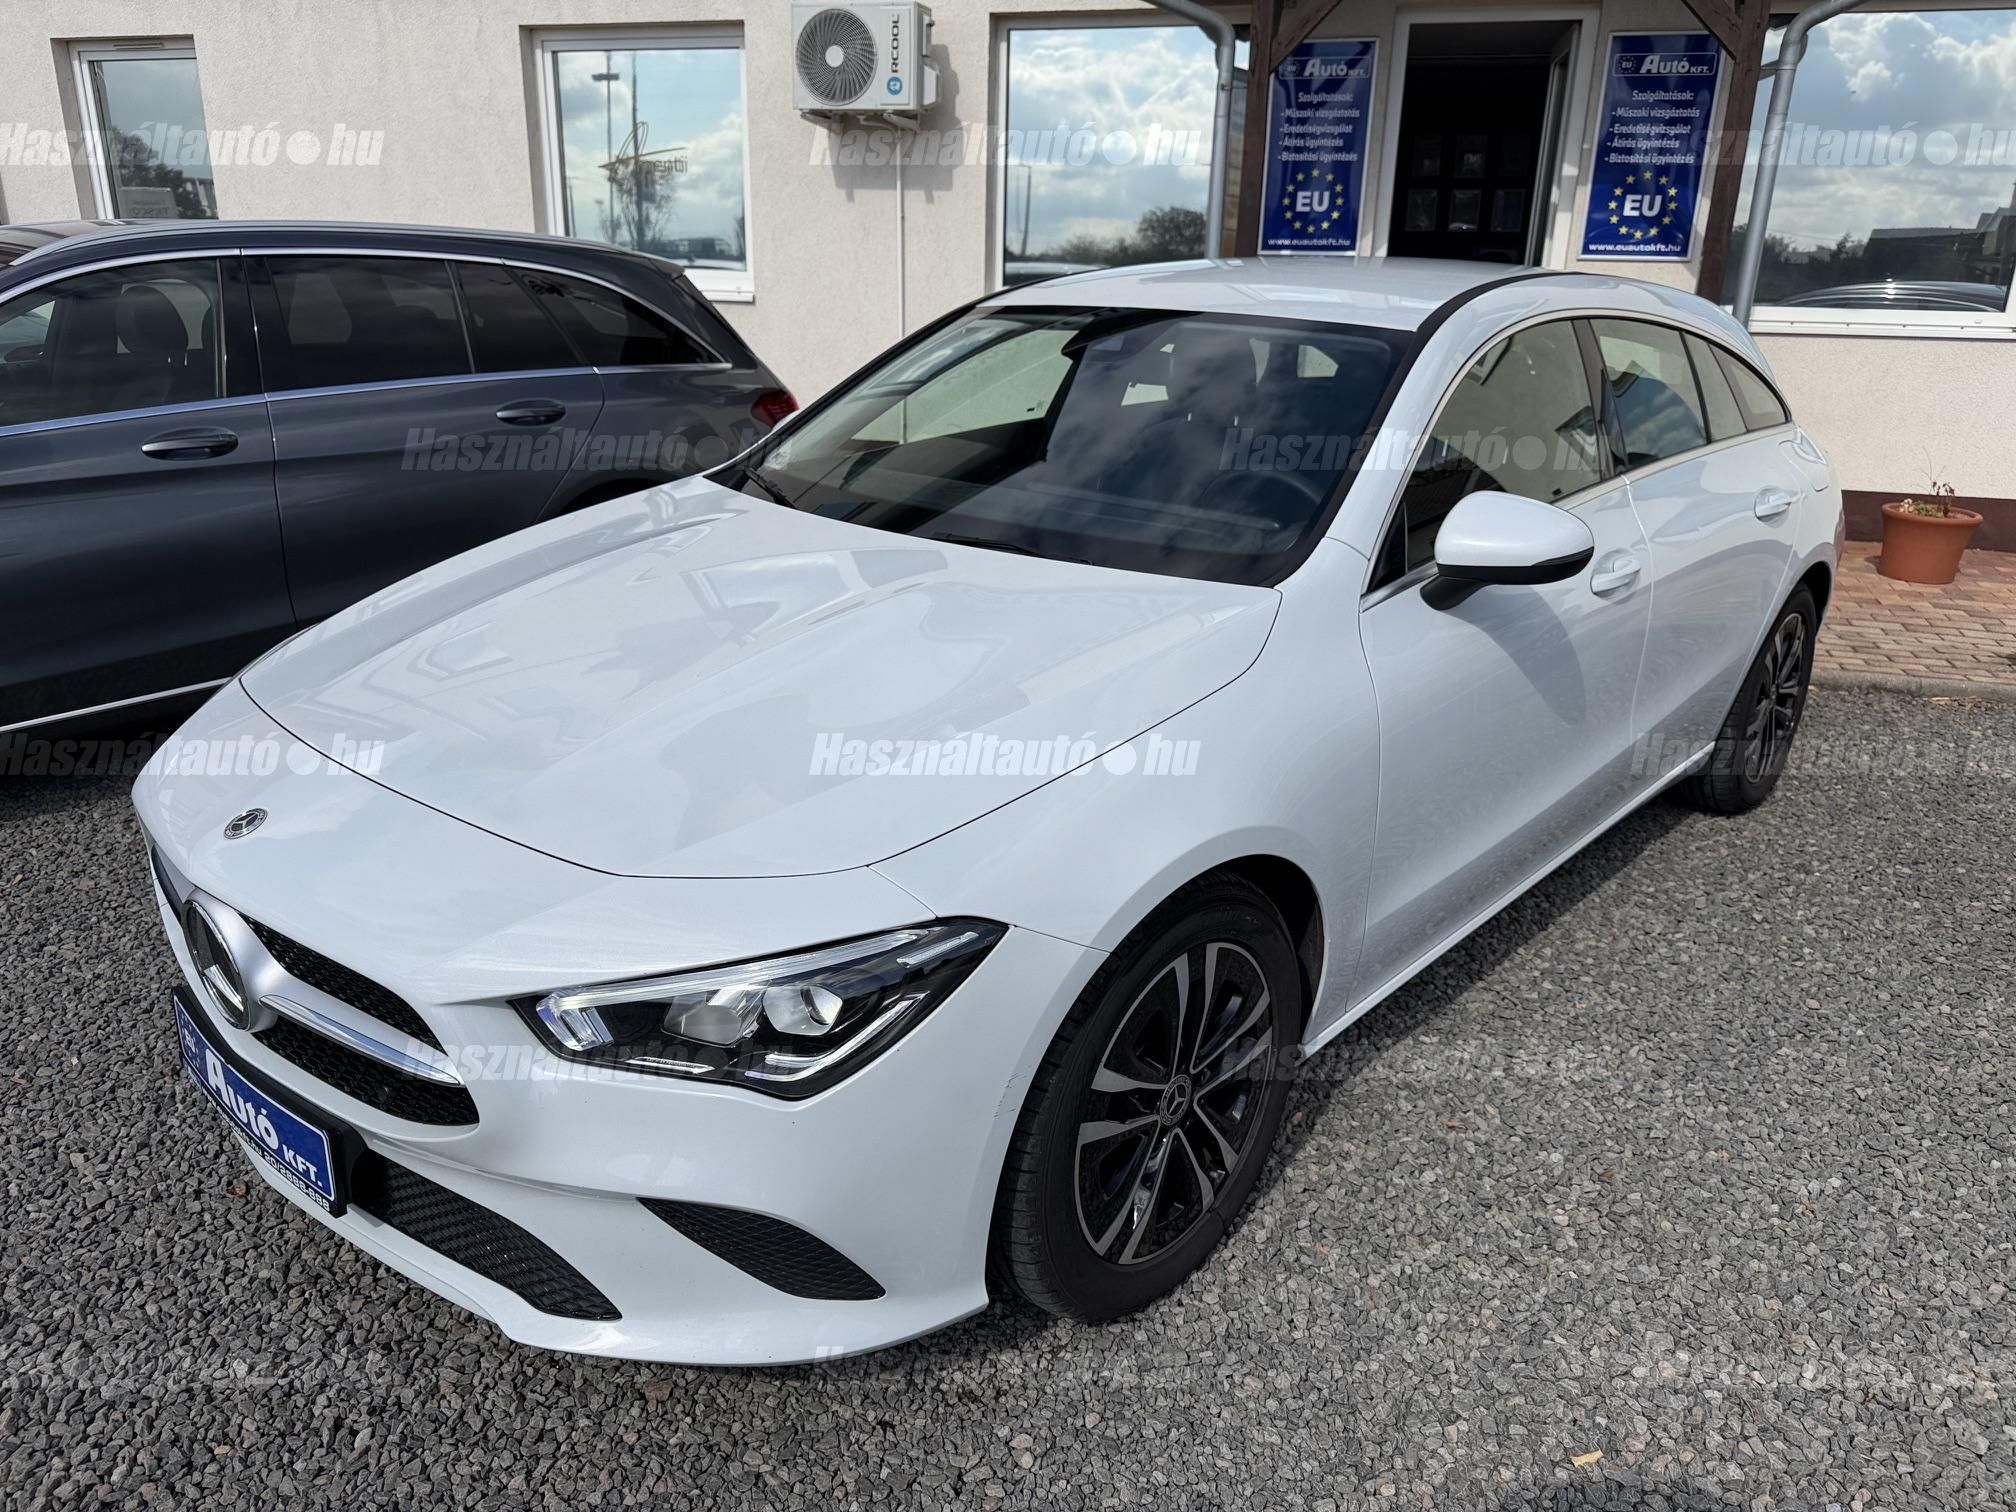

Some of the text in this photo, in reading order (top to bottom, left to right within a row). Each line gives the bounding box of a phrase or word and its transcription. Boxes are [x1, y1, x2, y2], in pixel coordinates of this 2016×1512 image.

[891, 14, 900, 73] RCOOL
[1303, 58, 1348, 77] Autó
[1640, 55, 1689, 74] Autó
[1295, 191, 1331, 213] EU
[1622, 194, 1663, 217] EU
[1588, 243, 1681, 253] www.euautokft.hu
[206, 1048, 323, 1187] Autó KFT.
